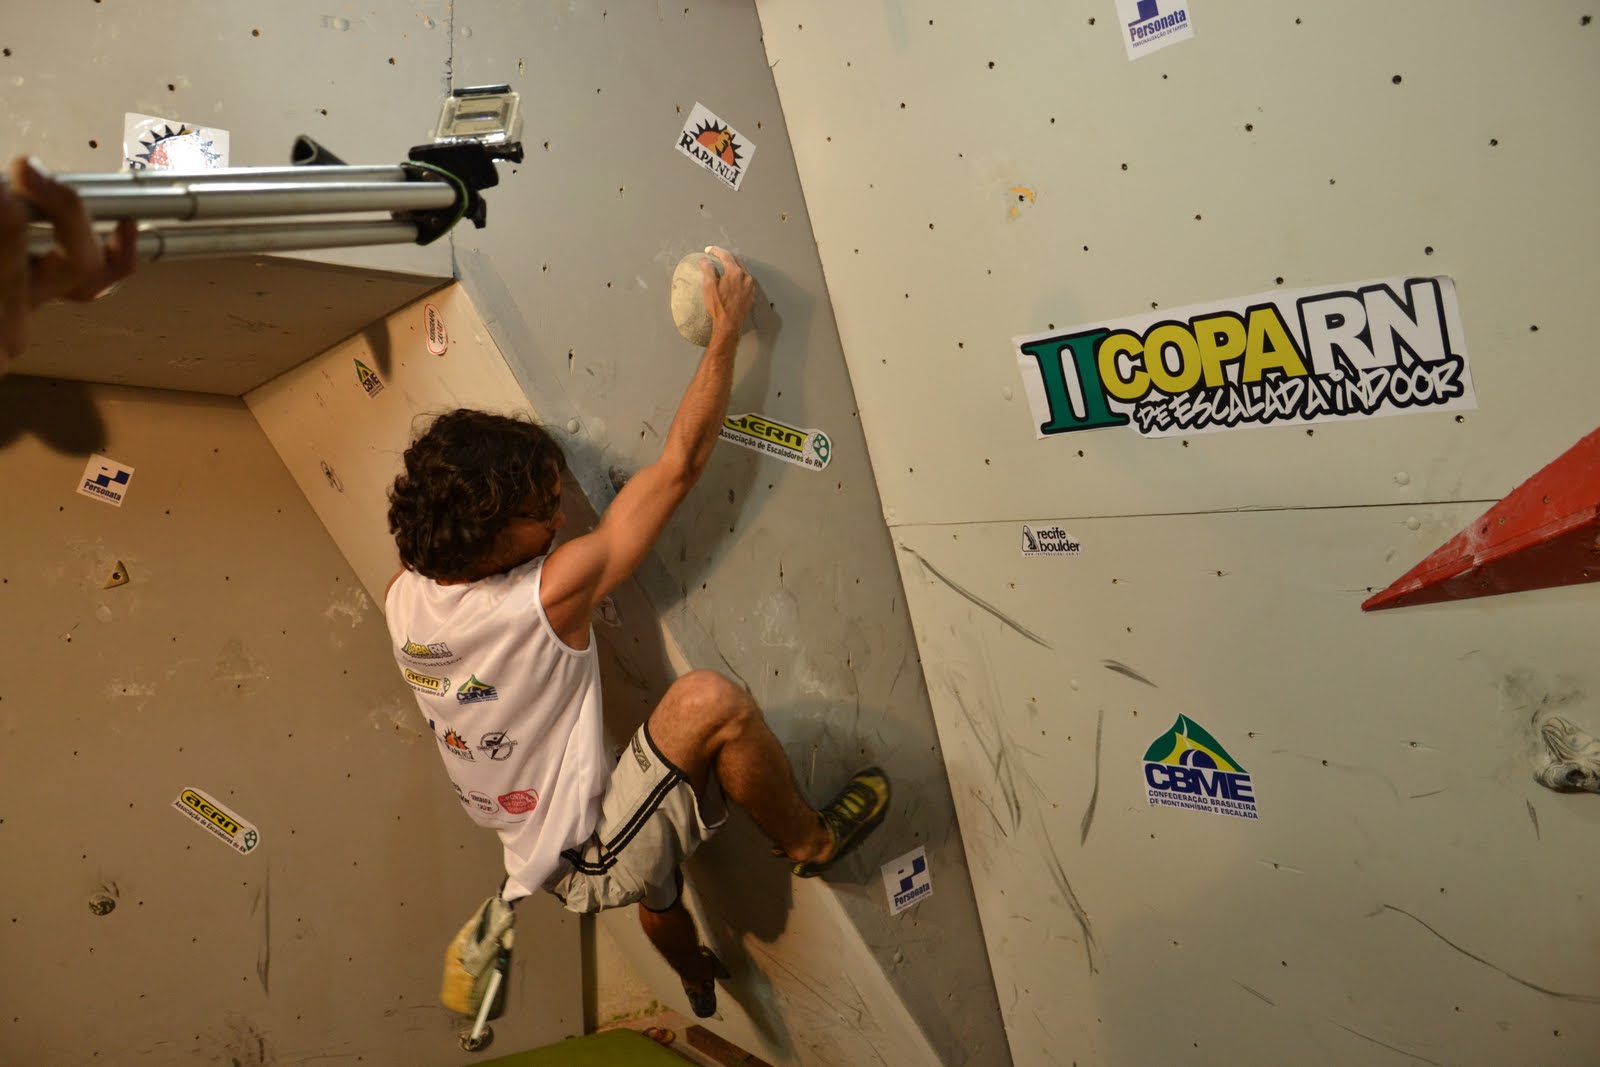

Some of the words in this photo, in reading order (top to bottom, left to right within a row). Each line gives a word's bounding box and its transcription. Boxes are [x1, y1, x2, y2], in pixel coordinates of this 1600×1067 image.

[1129, 9, 1187, 42] Personata
[679, 130, 714, 169] RAPA
[715, 161, 742, 186] NUI
[1021, 328, 1129, 434] II
[1098, 302, 1309, 402] COPA
[1298, 277, 1451, 377] RN
[1137, 402, 1172, 431] DE
[1168, 377, 1331, 427] ESCALADA
[720, 428, 757, 448] Associação
[756, 441, 766, 450] de
[766, 443, 804, 463] Escaladores
[804, 457, 813, 465] do
[813, 459, 823, 468] RN
[84, 481, 121, 501] Personata
[1036, 526, 1066, 540] recife
[1038, 539, 1080, 552] boulder
[427, 642, 450, 655] RN
[456, 686, 498, 701] CBME
[1144, 762, 1255, 803] CBME
[1148, 790, 1208, 805] CONFEDERAÇÃO
[1210, 799, 1257, 812] BRASILEIRA
[175, 800, 201, 822] Associação
[206, 822, 233, 845] Escaladores
[232, 841, 240, 849] do
[1220, 808, 1258, 820] ESCALADA
[894, 882, 930, 907] Personata
